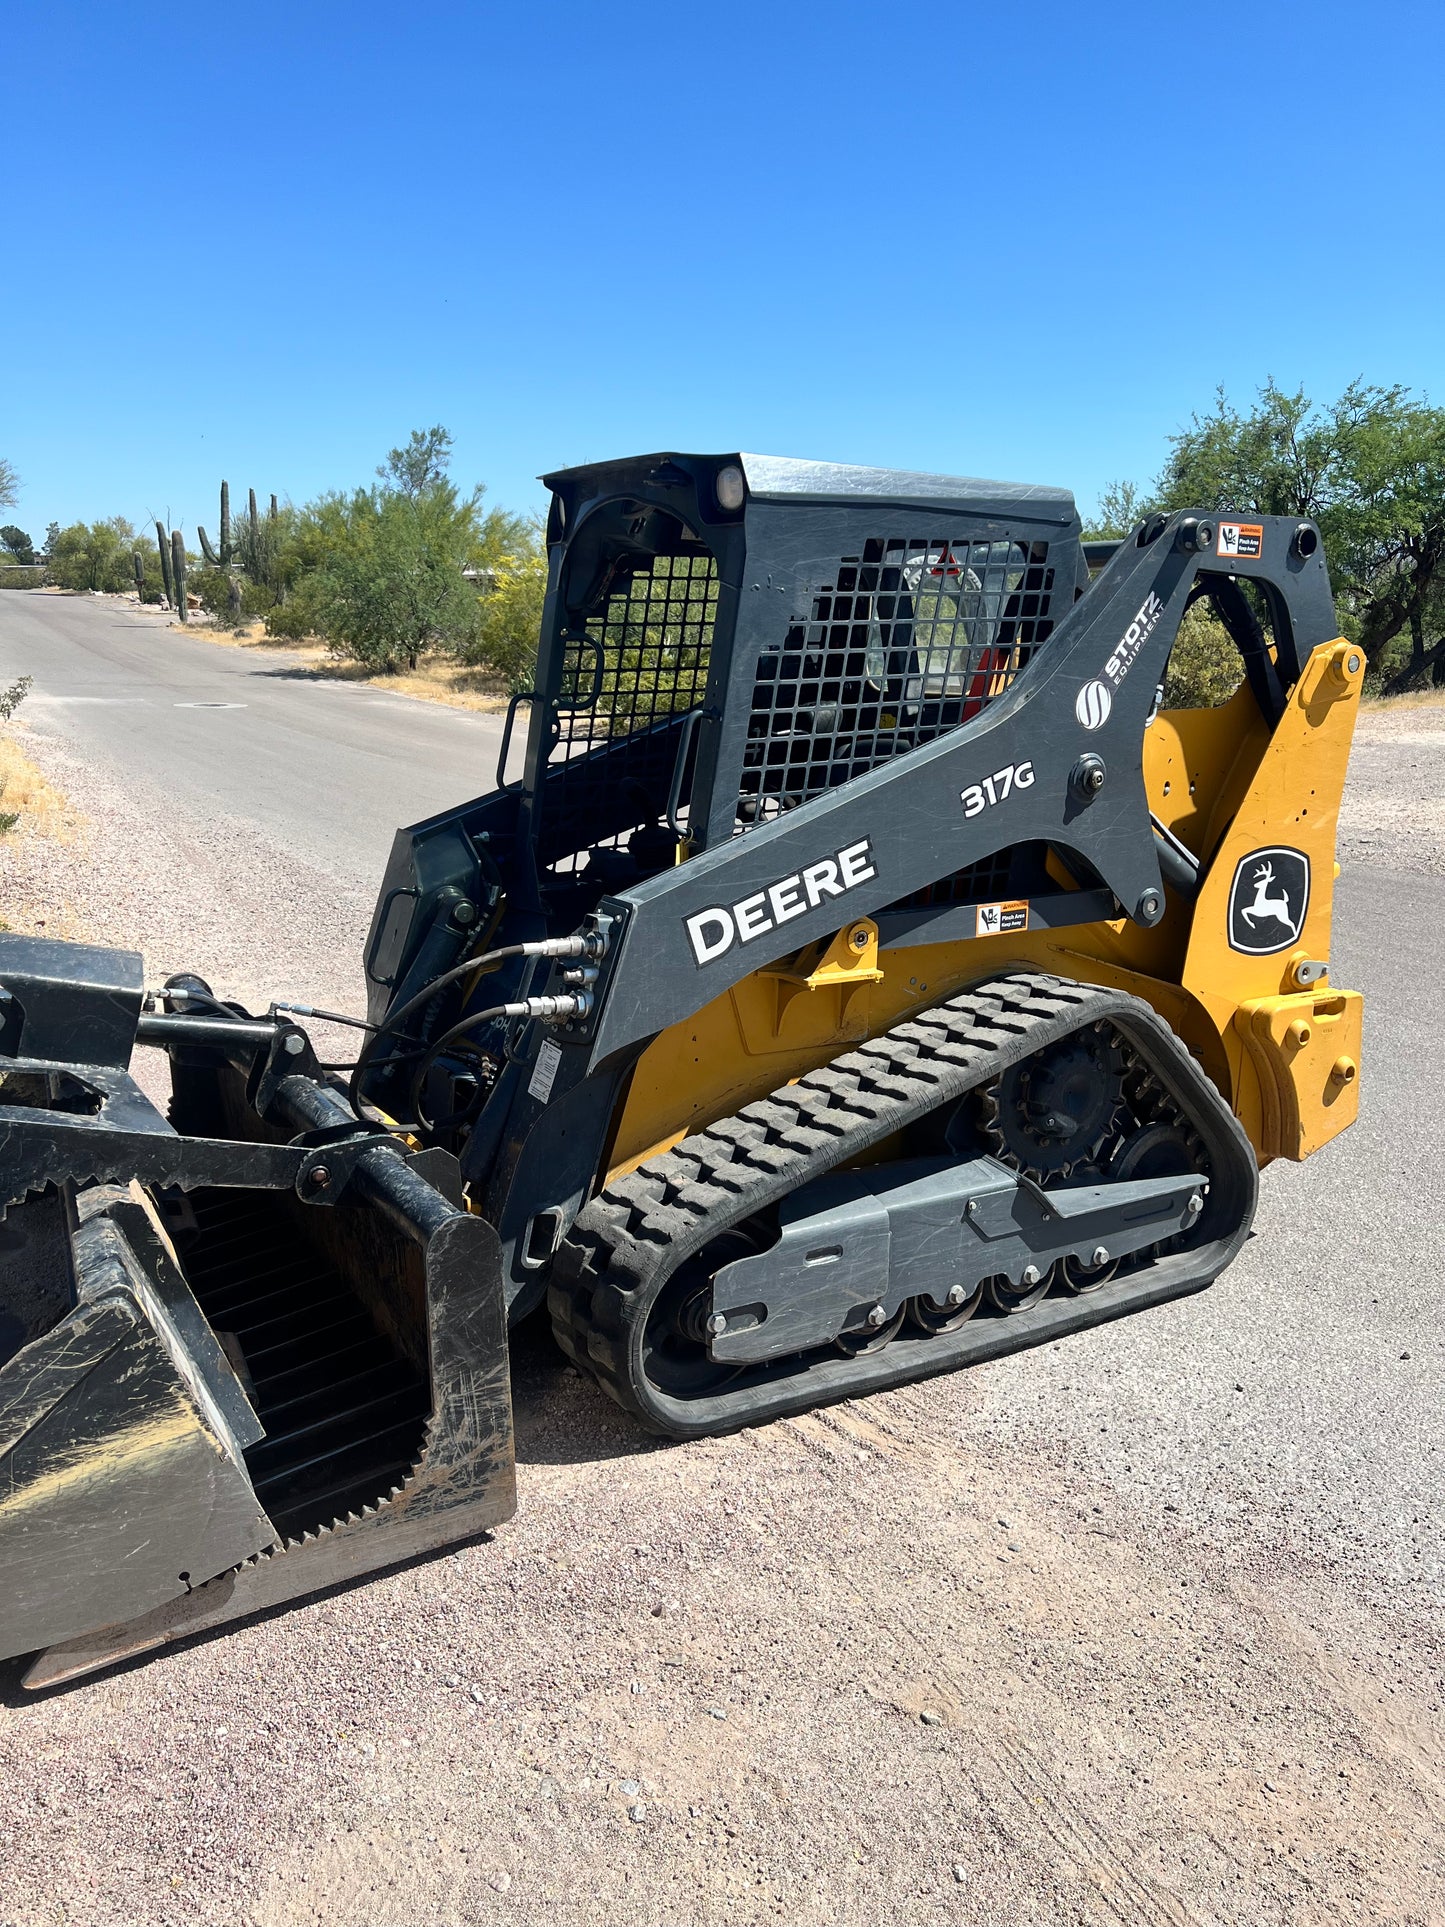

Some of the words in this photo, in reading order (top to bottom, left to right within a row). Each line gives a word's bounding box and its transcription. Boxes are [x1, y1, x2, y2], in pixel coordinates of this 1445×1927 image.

[1104, 590, 1161, 678] STOTZ
[1113, 602, 1166, 686] EQUIPMENT
[959, 760, 1036, 819] 317G
[684, 838, 877, 966] DEERE
